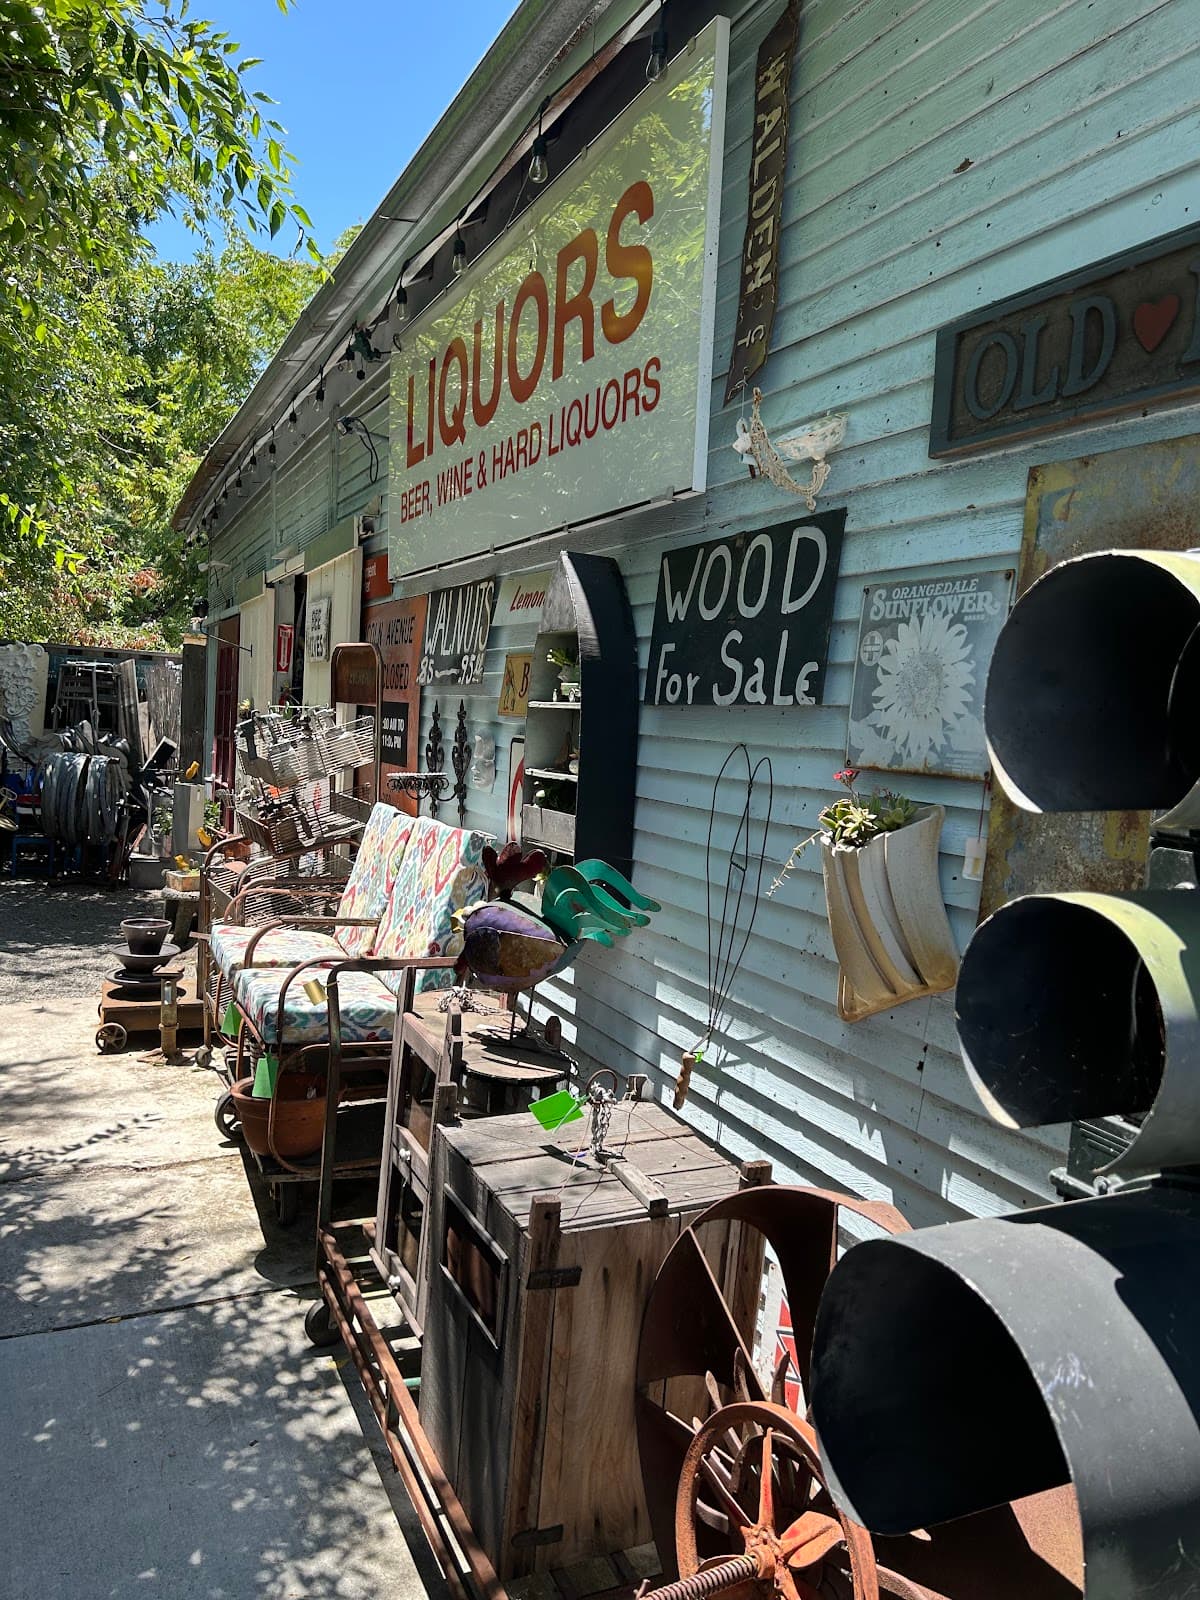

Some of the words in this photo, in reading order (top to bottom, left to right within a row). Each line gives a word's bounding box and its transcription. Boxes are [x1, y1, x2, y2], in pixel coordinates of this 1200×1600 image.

[406, 180, 654, 469] LIQUORS
[964, 295, 1116, 421] OLD
[400, 480, 433, 524] BEER,
[437, 450, 473, 507] WINE
[477, 450, 487, 489] &
[492, 421, 542, 483] HARD
[548, 356, 661, 457] LIQUORS
[509, 585, 547, 612] Lemon
[662, 525, 828, 624] WOOD
[869, 588, 1001, 621] SUNFLOWER
[892, 578, 979, 599] ORANGEDALE
[386, 616, 416, 646] AVENUE
[424, 580, 495, 656] WALNUTS
[655, 642, 700, 705] For
